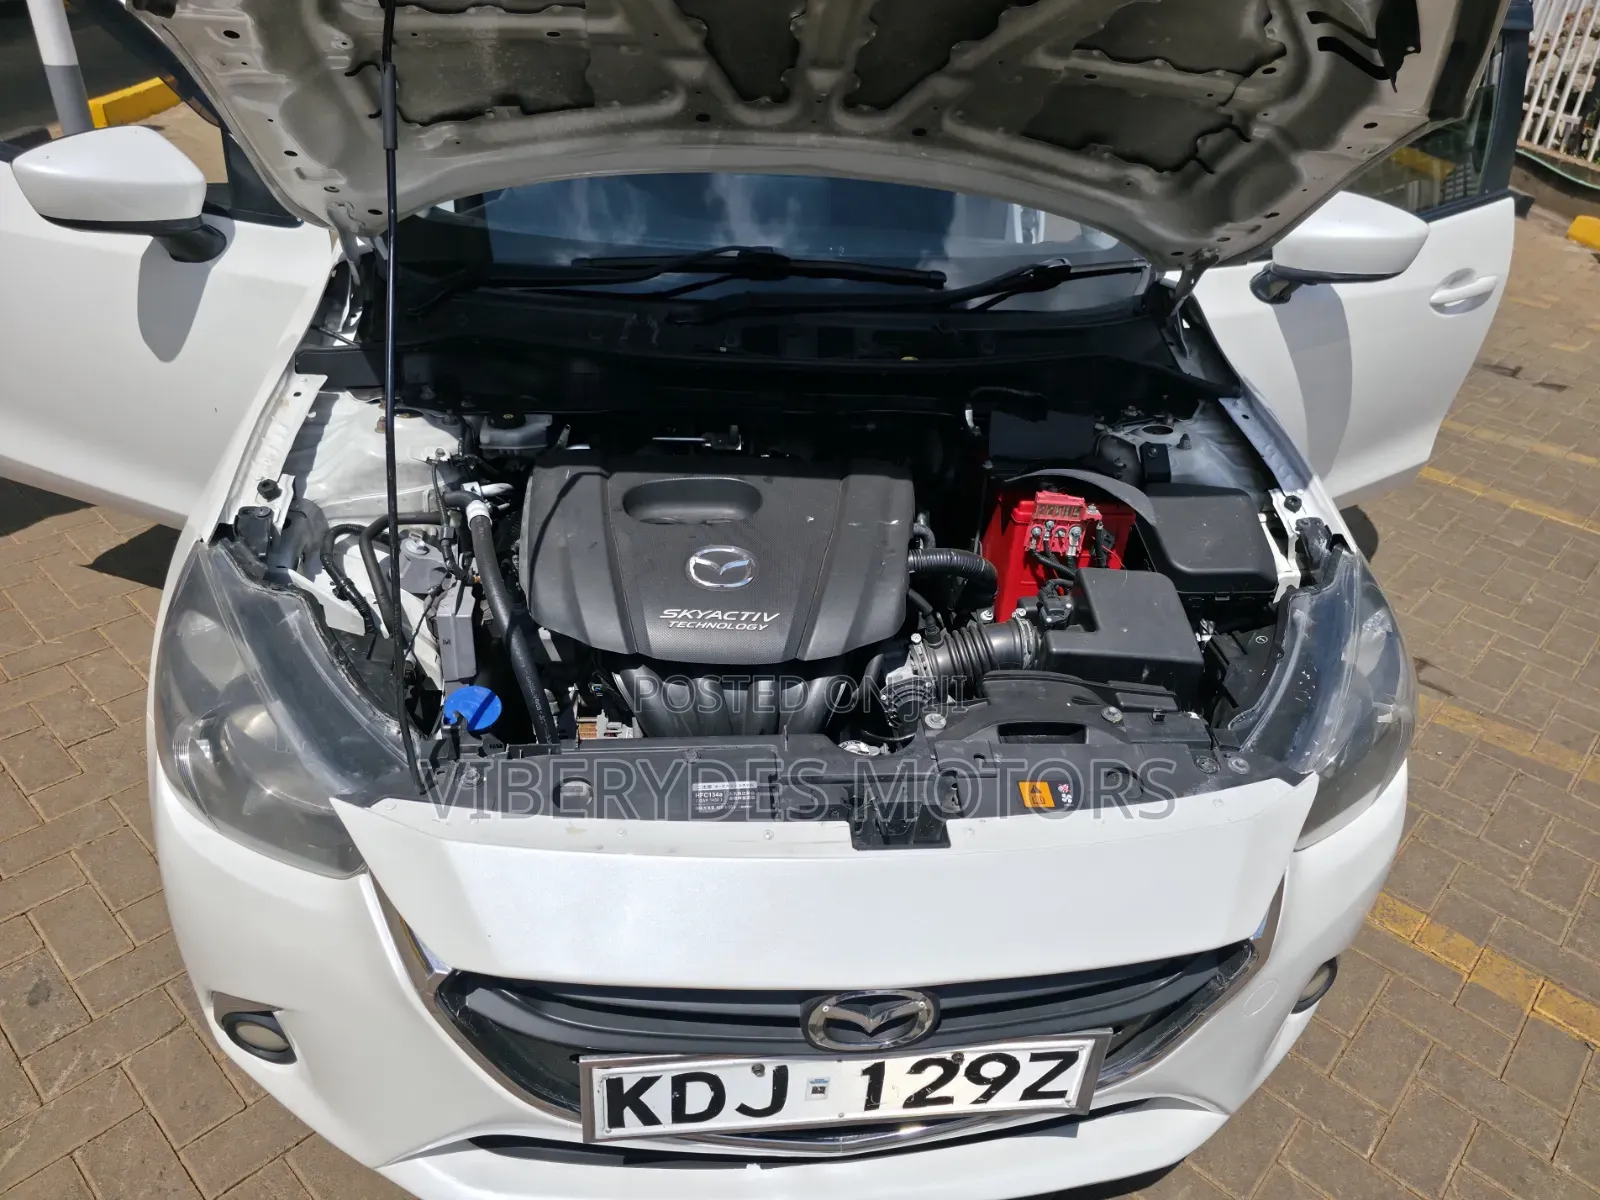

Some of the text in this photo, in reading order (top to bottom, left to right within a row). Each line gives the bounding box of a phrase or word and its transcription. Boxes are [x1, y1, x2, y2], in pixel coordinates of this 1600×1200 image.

[659, 608, 780, 622] SKYACTIV
[668, 620, 769, 631] TECHNOLOGY
[605, 1050, 1080, 1129] KDJ 129Z
